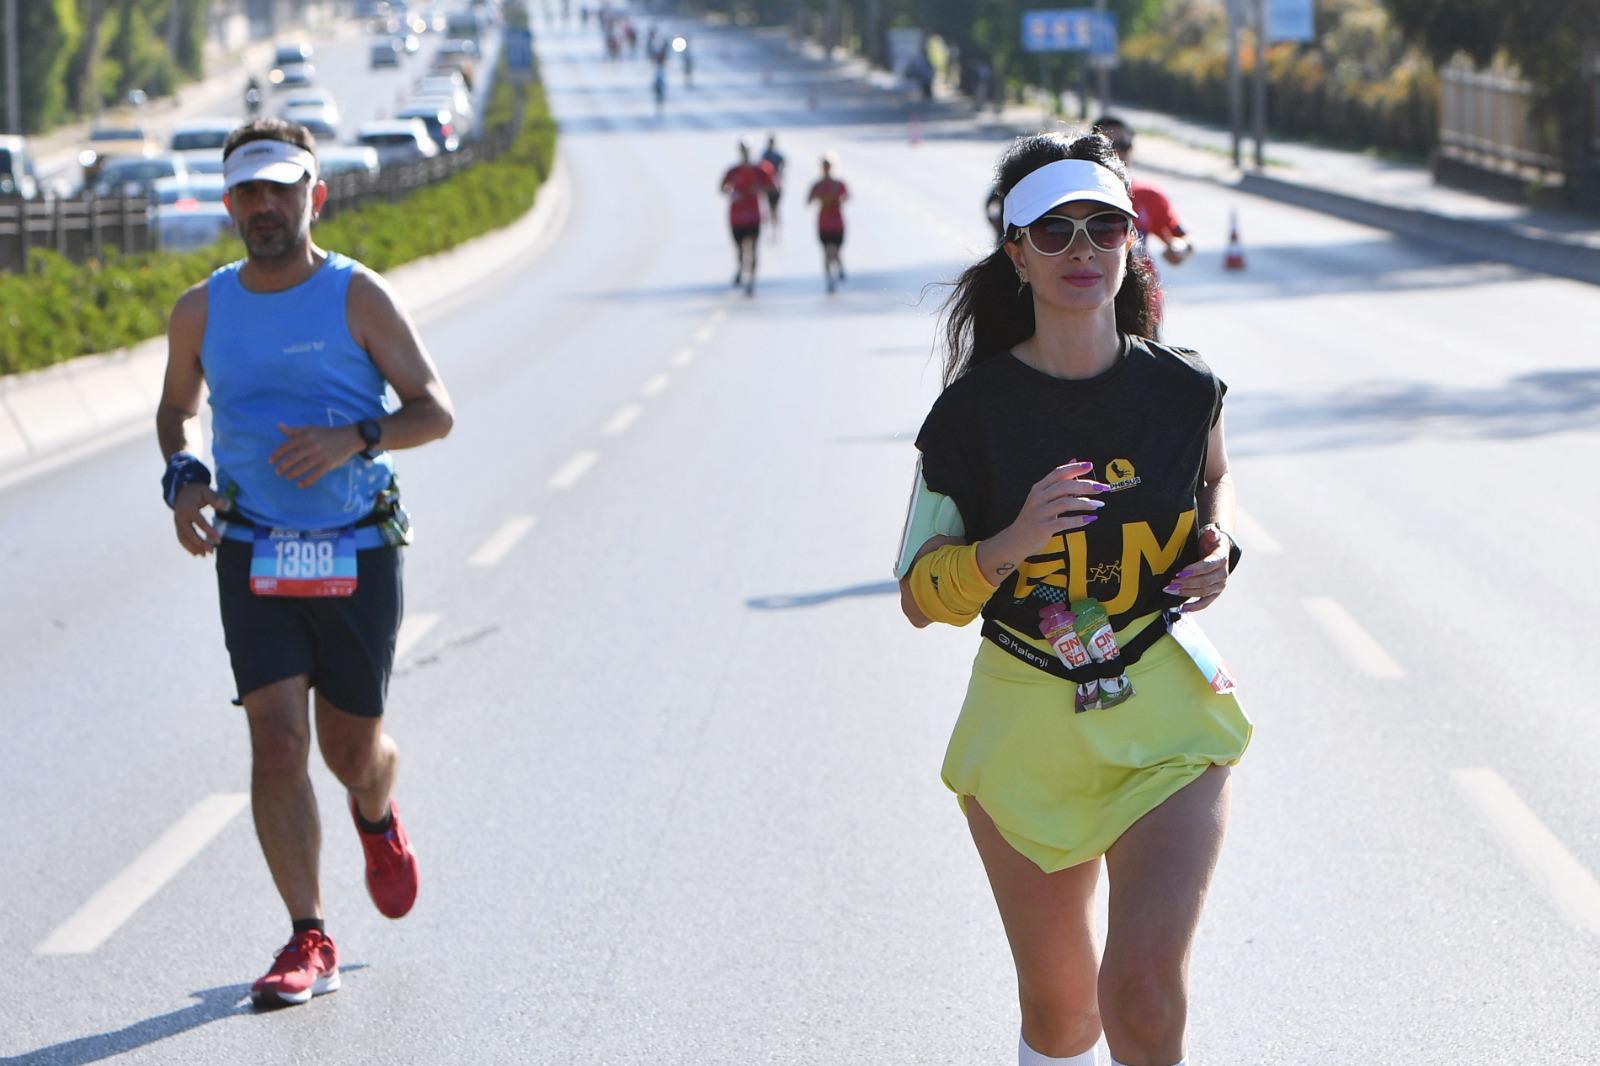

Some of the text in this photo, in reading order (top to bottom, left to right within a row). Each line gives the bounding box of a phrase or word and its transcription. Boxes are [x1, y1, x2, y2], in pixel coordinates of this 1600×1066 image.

[1109, 476, 1142, 490] PHESUS
[274, 540, 334, 578] 1398
[1010, 640, 1049, 667] Kalenji
